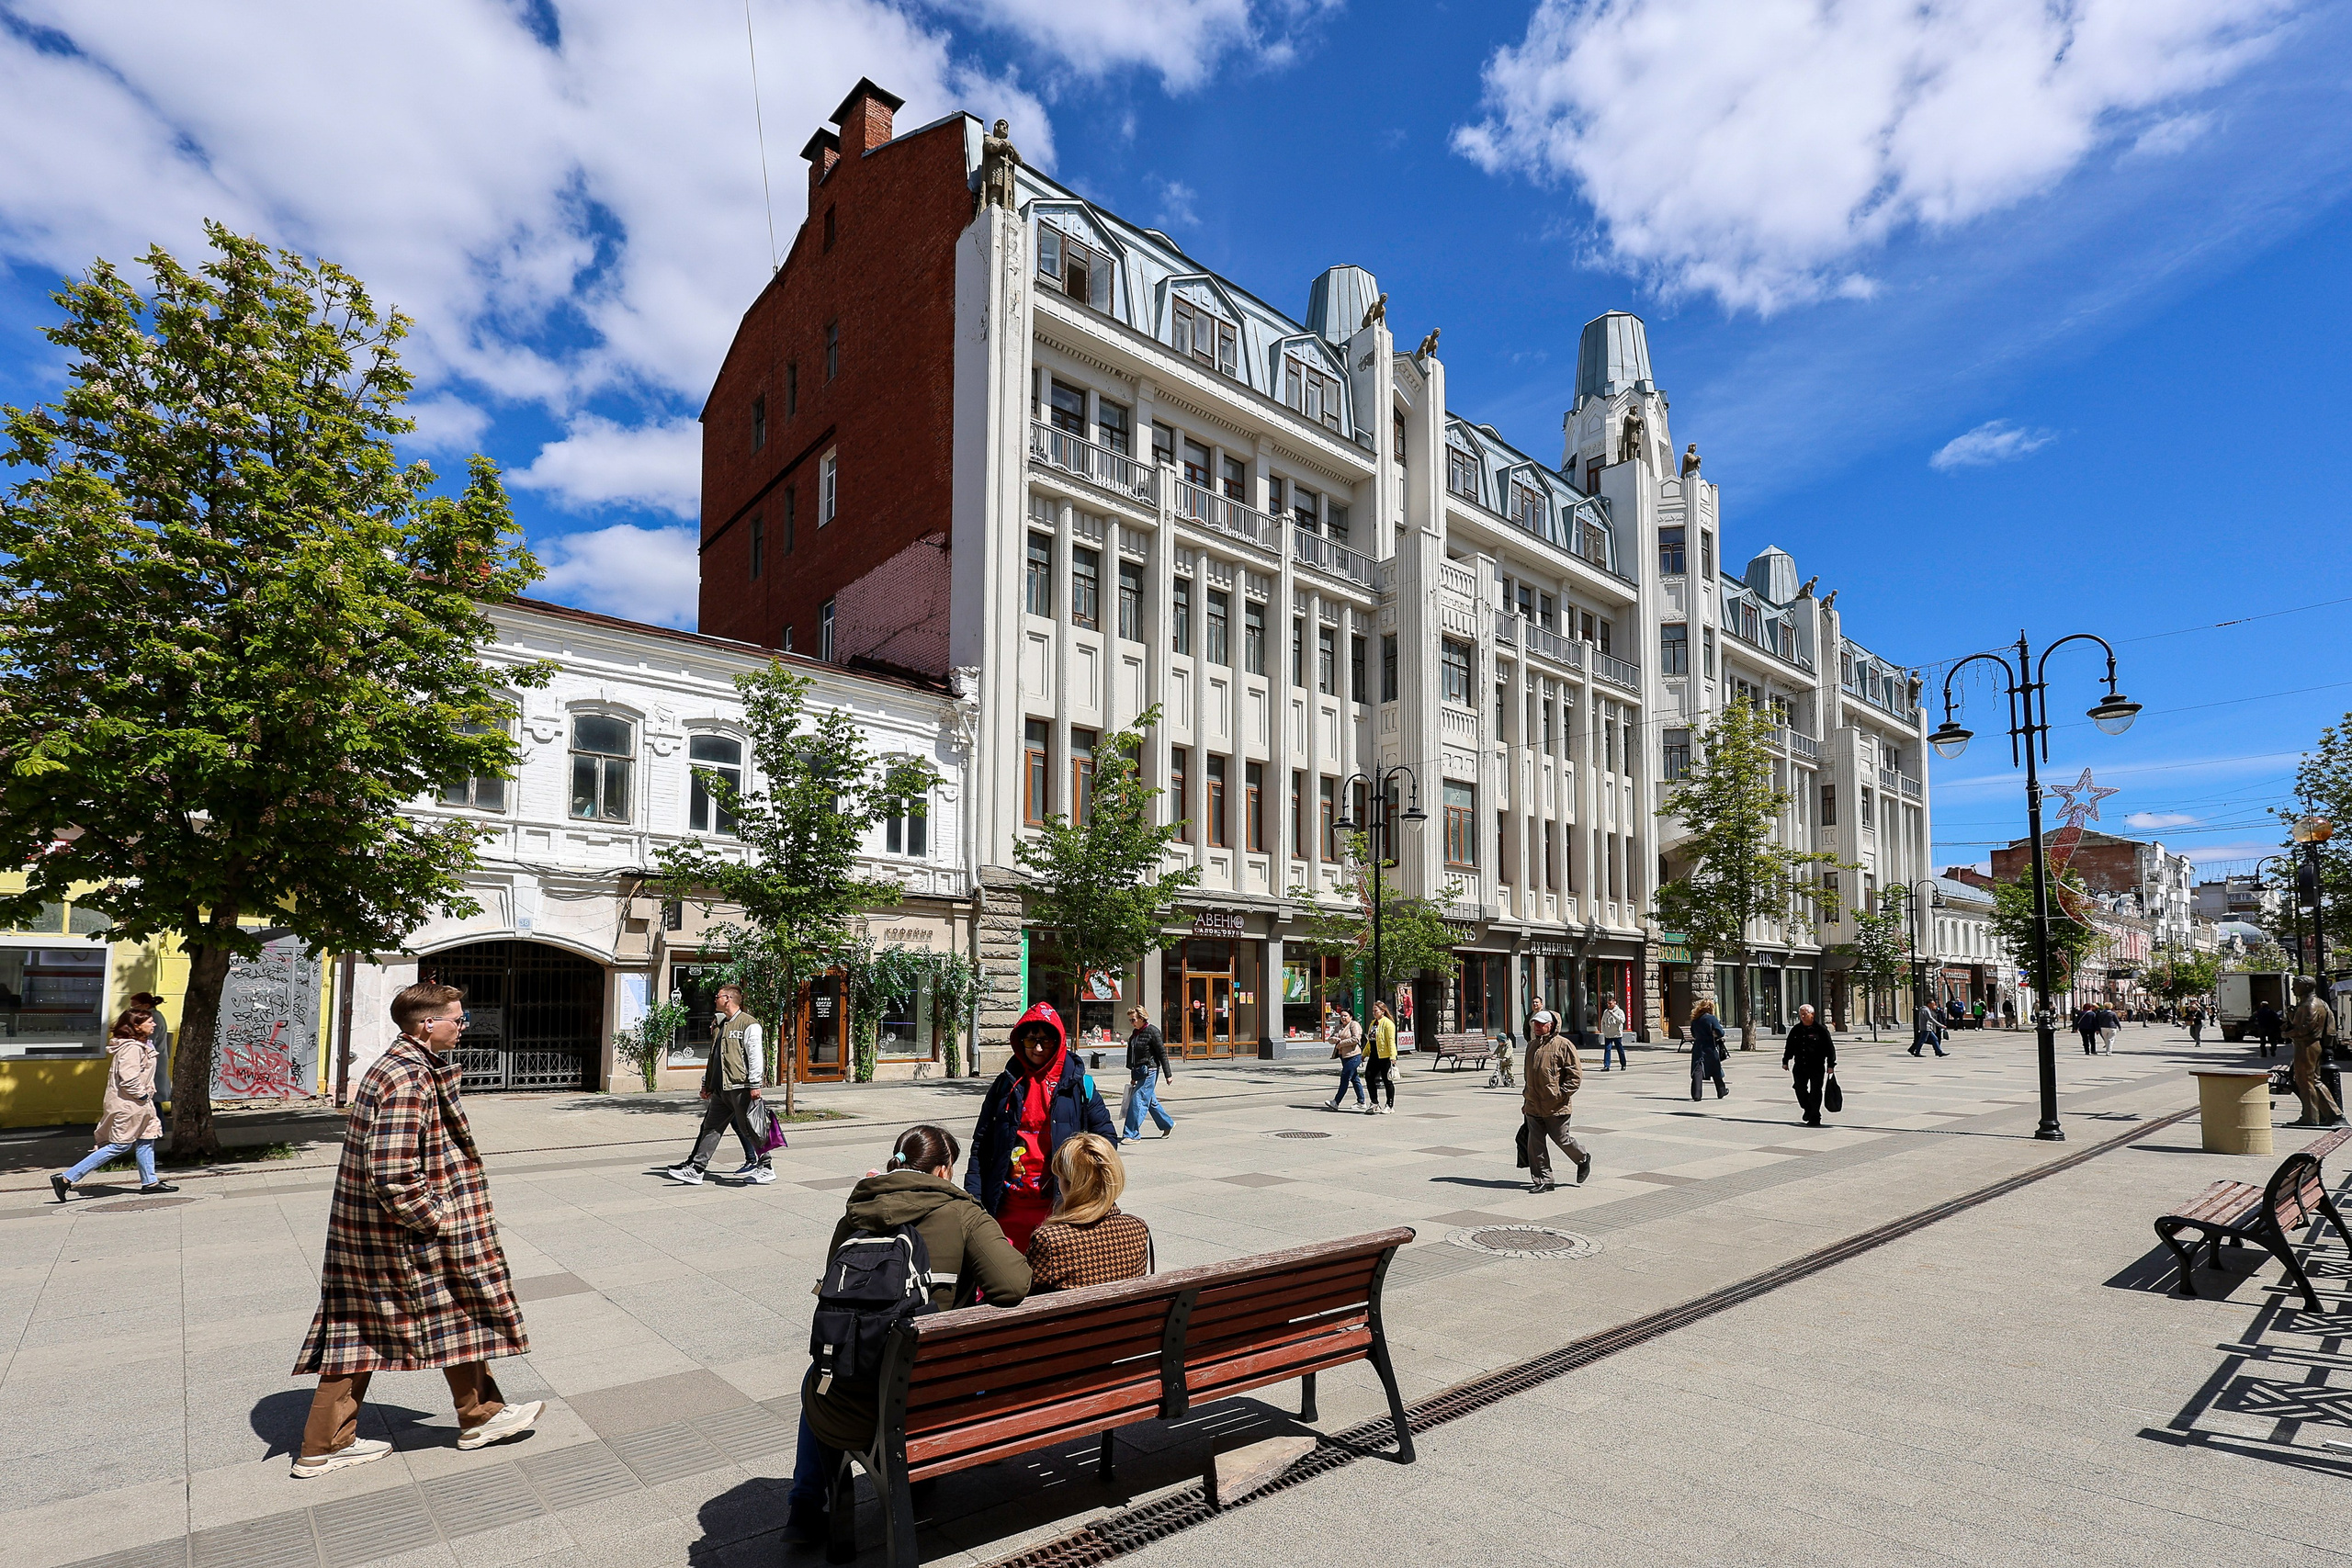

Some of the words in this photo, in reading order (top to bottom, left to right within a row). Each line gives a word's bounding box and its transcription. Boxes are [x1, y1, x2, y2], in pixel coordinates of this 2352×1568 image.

[1194, 913, 1245, 929] АВЕНЮ
[886, 928, 933, 936] кофейня
[1443, 920, 1477, 942] IVA'S
[1531, 942, 1573, 953] ДУБЛЕНКИ
[1759, 953, 1773, 965] ELIS
